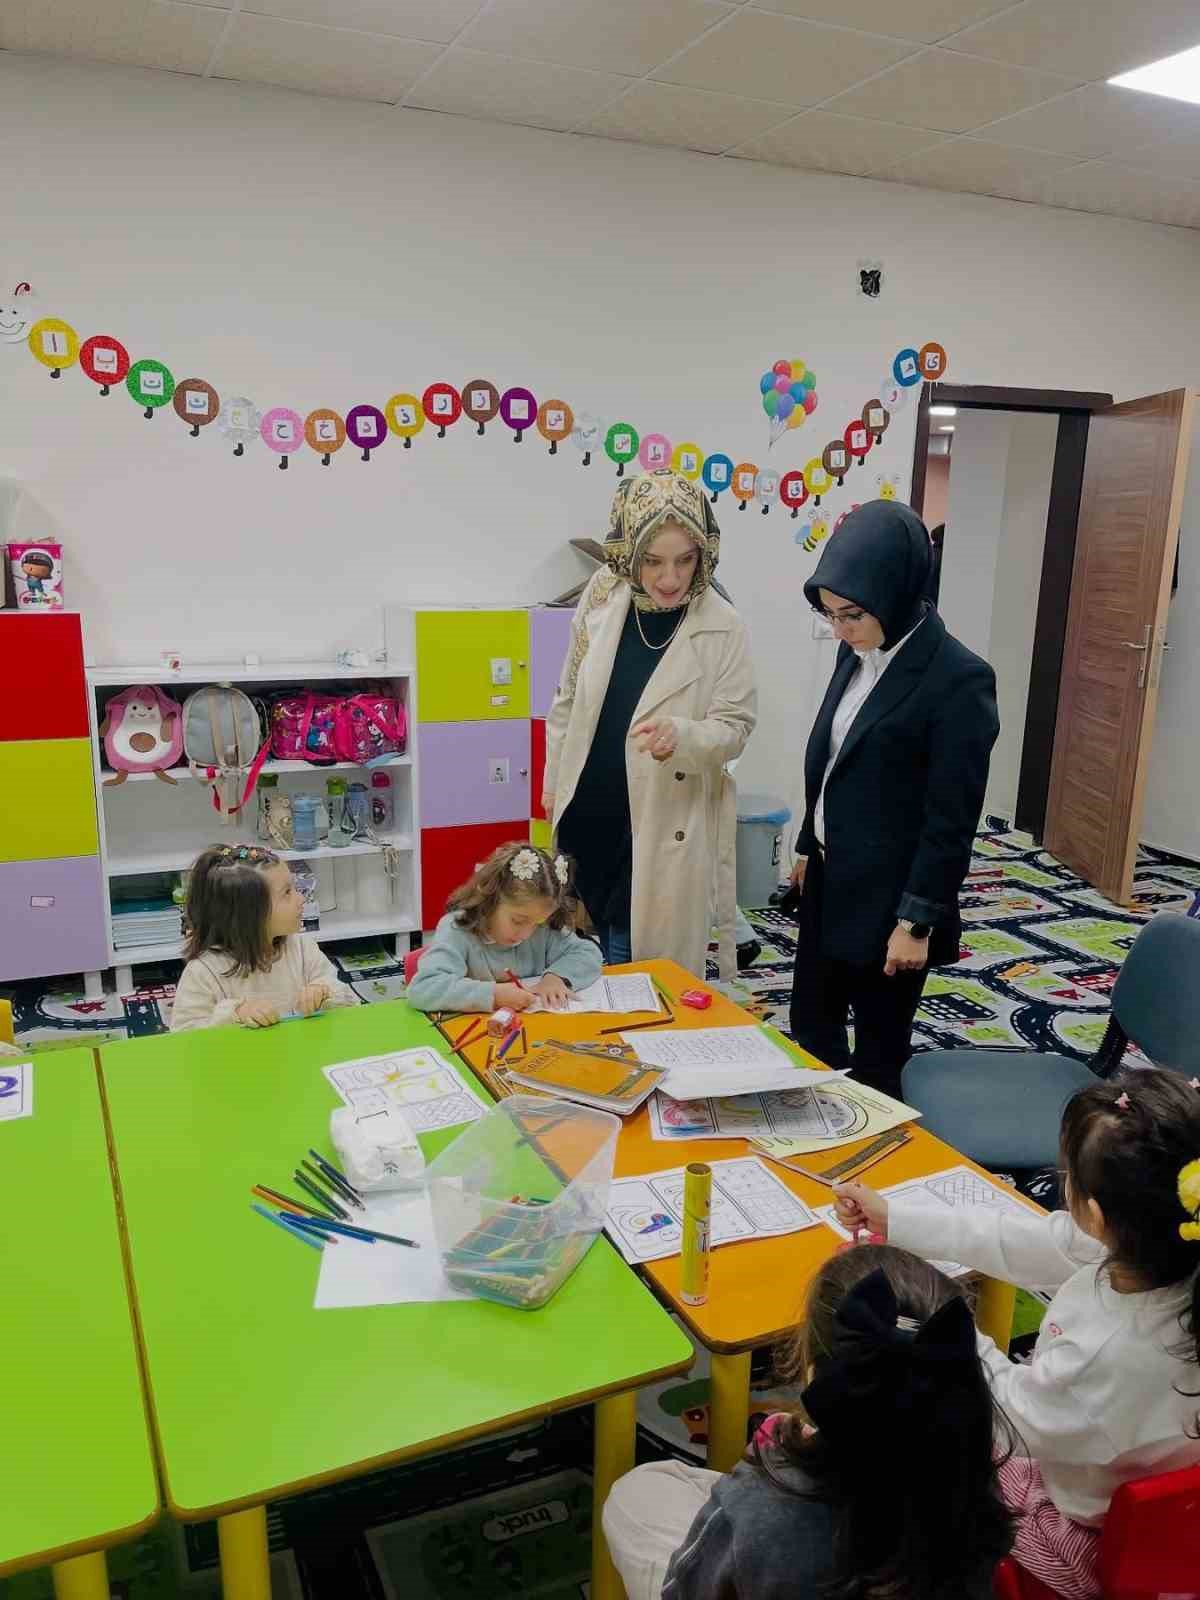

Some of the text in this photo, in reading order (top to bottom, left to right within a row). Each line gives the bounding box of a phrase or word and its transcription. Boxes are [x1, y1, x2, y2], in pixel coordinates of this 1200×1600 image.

[96, 354, 115, 369] ب
[143, 379, 161, 389] ت
[277, 424, 289, 439] ح
[320, 421, 332, 438] خ
[400, 408, 410, 424] ذ
[438, 398, 448, 411] ر
[473, 392, 485, 409] ز
[650, 444, 661, 460] ط
[498, 1508, 552, 1534] truck
